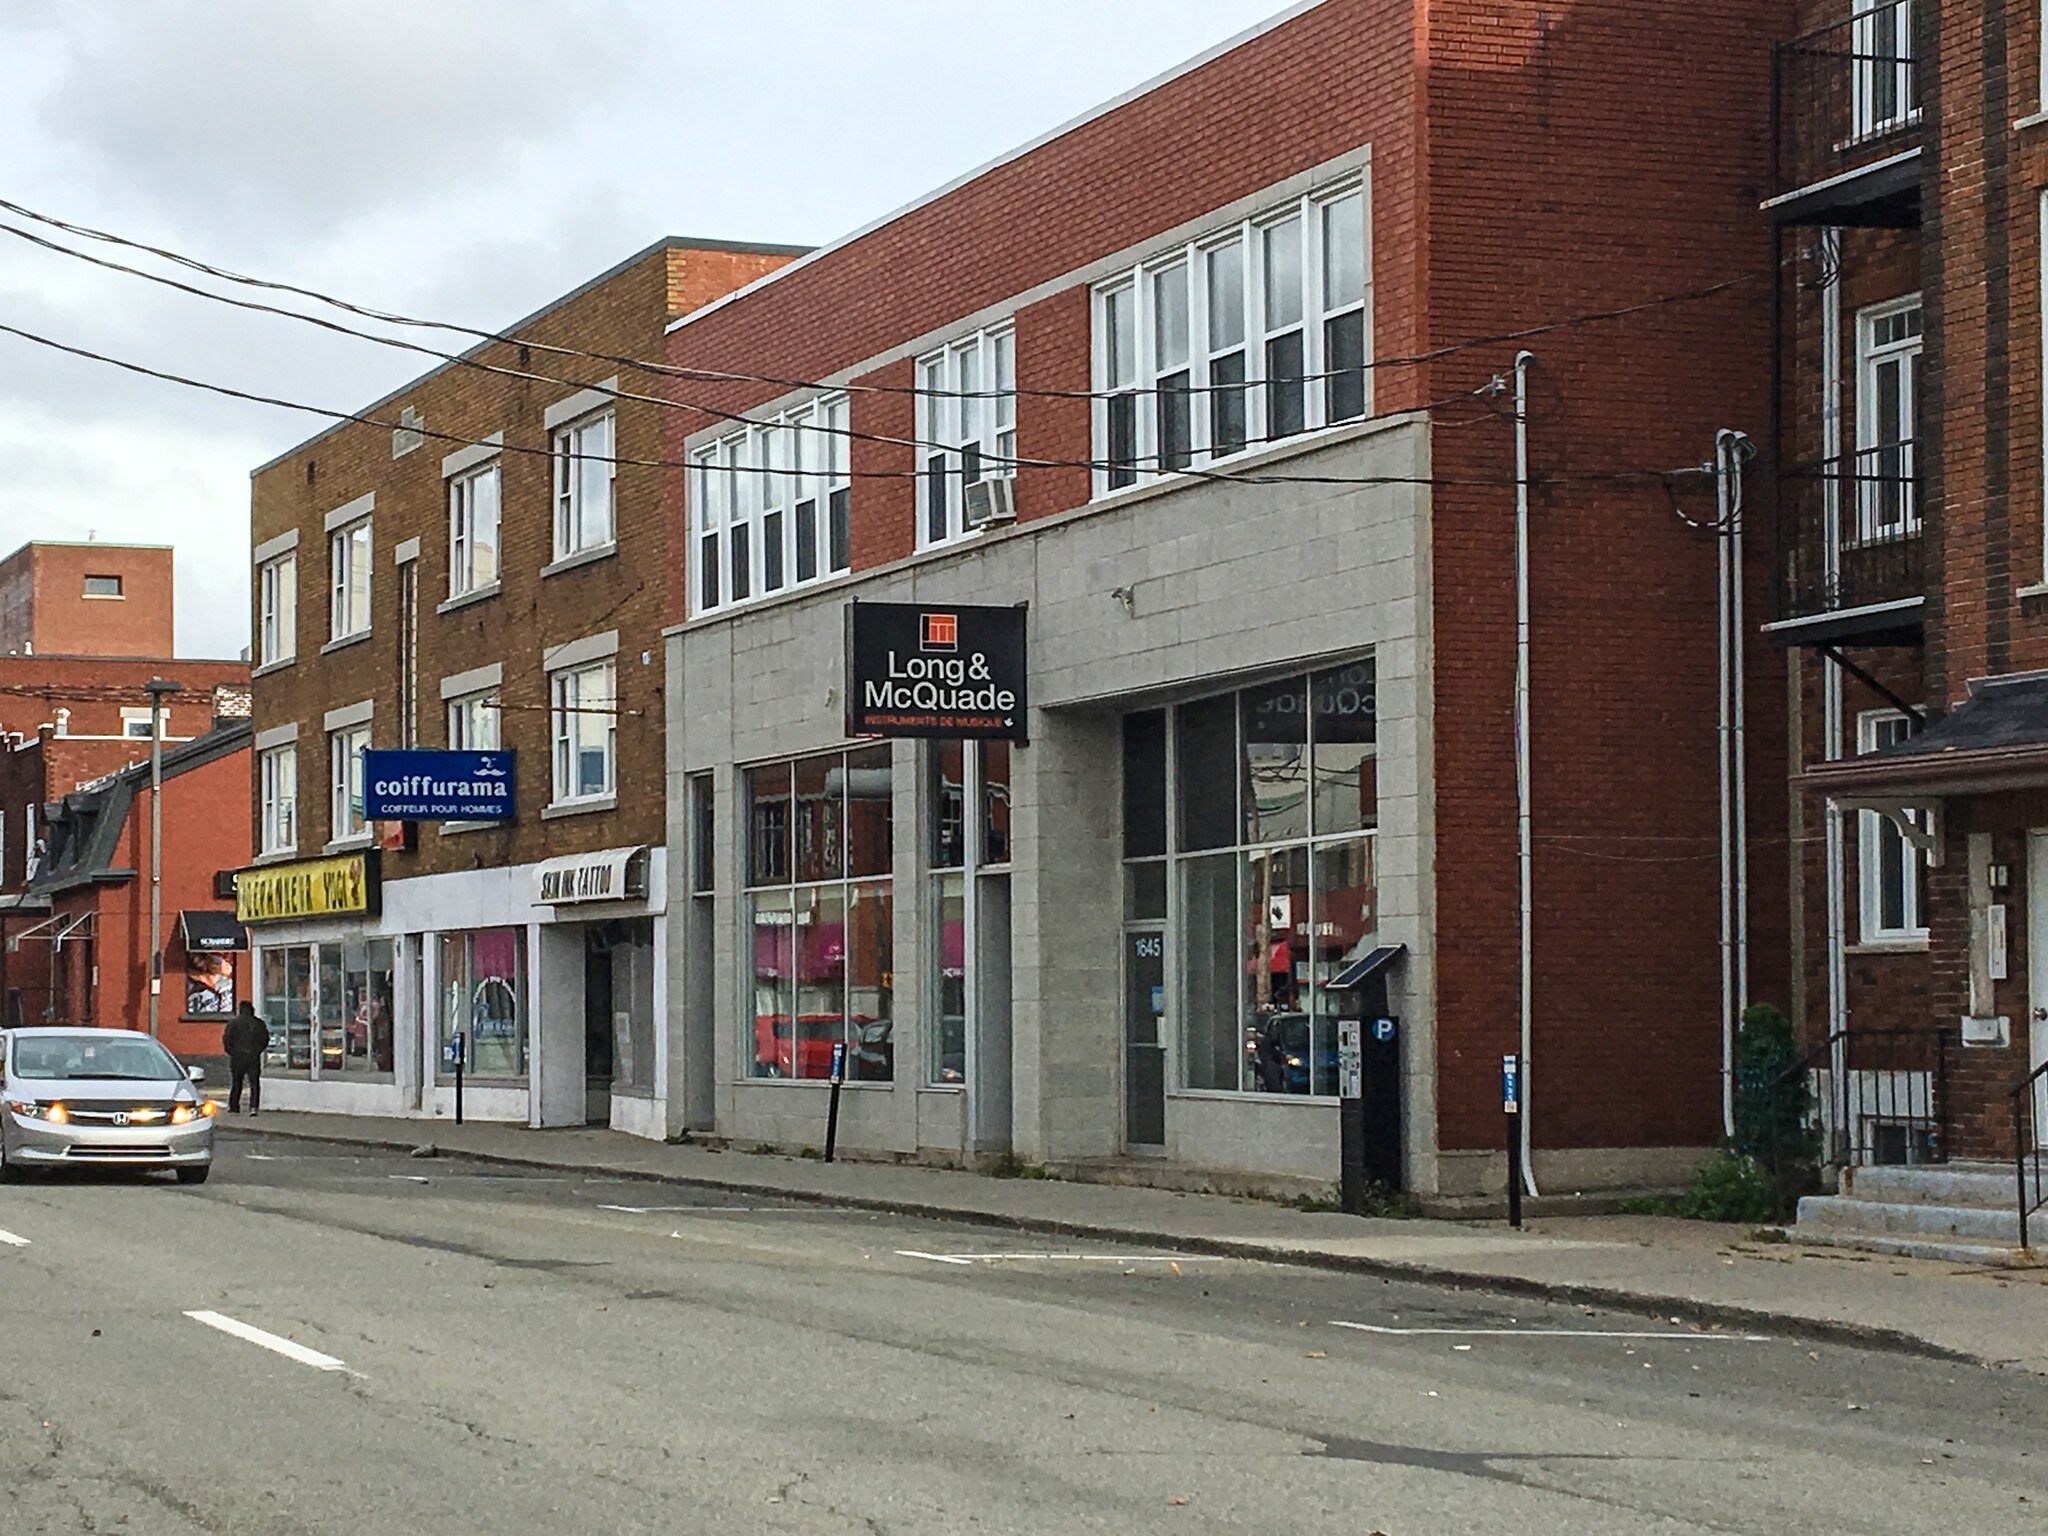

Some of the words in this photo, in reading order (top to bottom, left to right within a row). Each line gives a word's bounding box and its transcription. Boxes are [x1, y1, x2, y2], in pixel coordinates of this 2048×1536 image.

[888, 650, 965, 686] Long
[968, 652, 991, 681] &
[865, 681, 1015, 711] McQuade
[940, 716, 954, 727] DE
[375, 775, 507, 797] coiffurama
[381, 803, 429, 814] COIFFEUR
[431, 804, 458, 814] POUR
[460, 804, 503, 814] HOMMES
[578, 864, 612, 896] TATTOO
[1135, 938, 1160, 957] 1645
[1377, 1019, 1392, 1039] P
